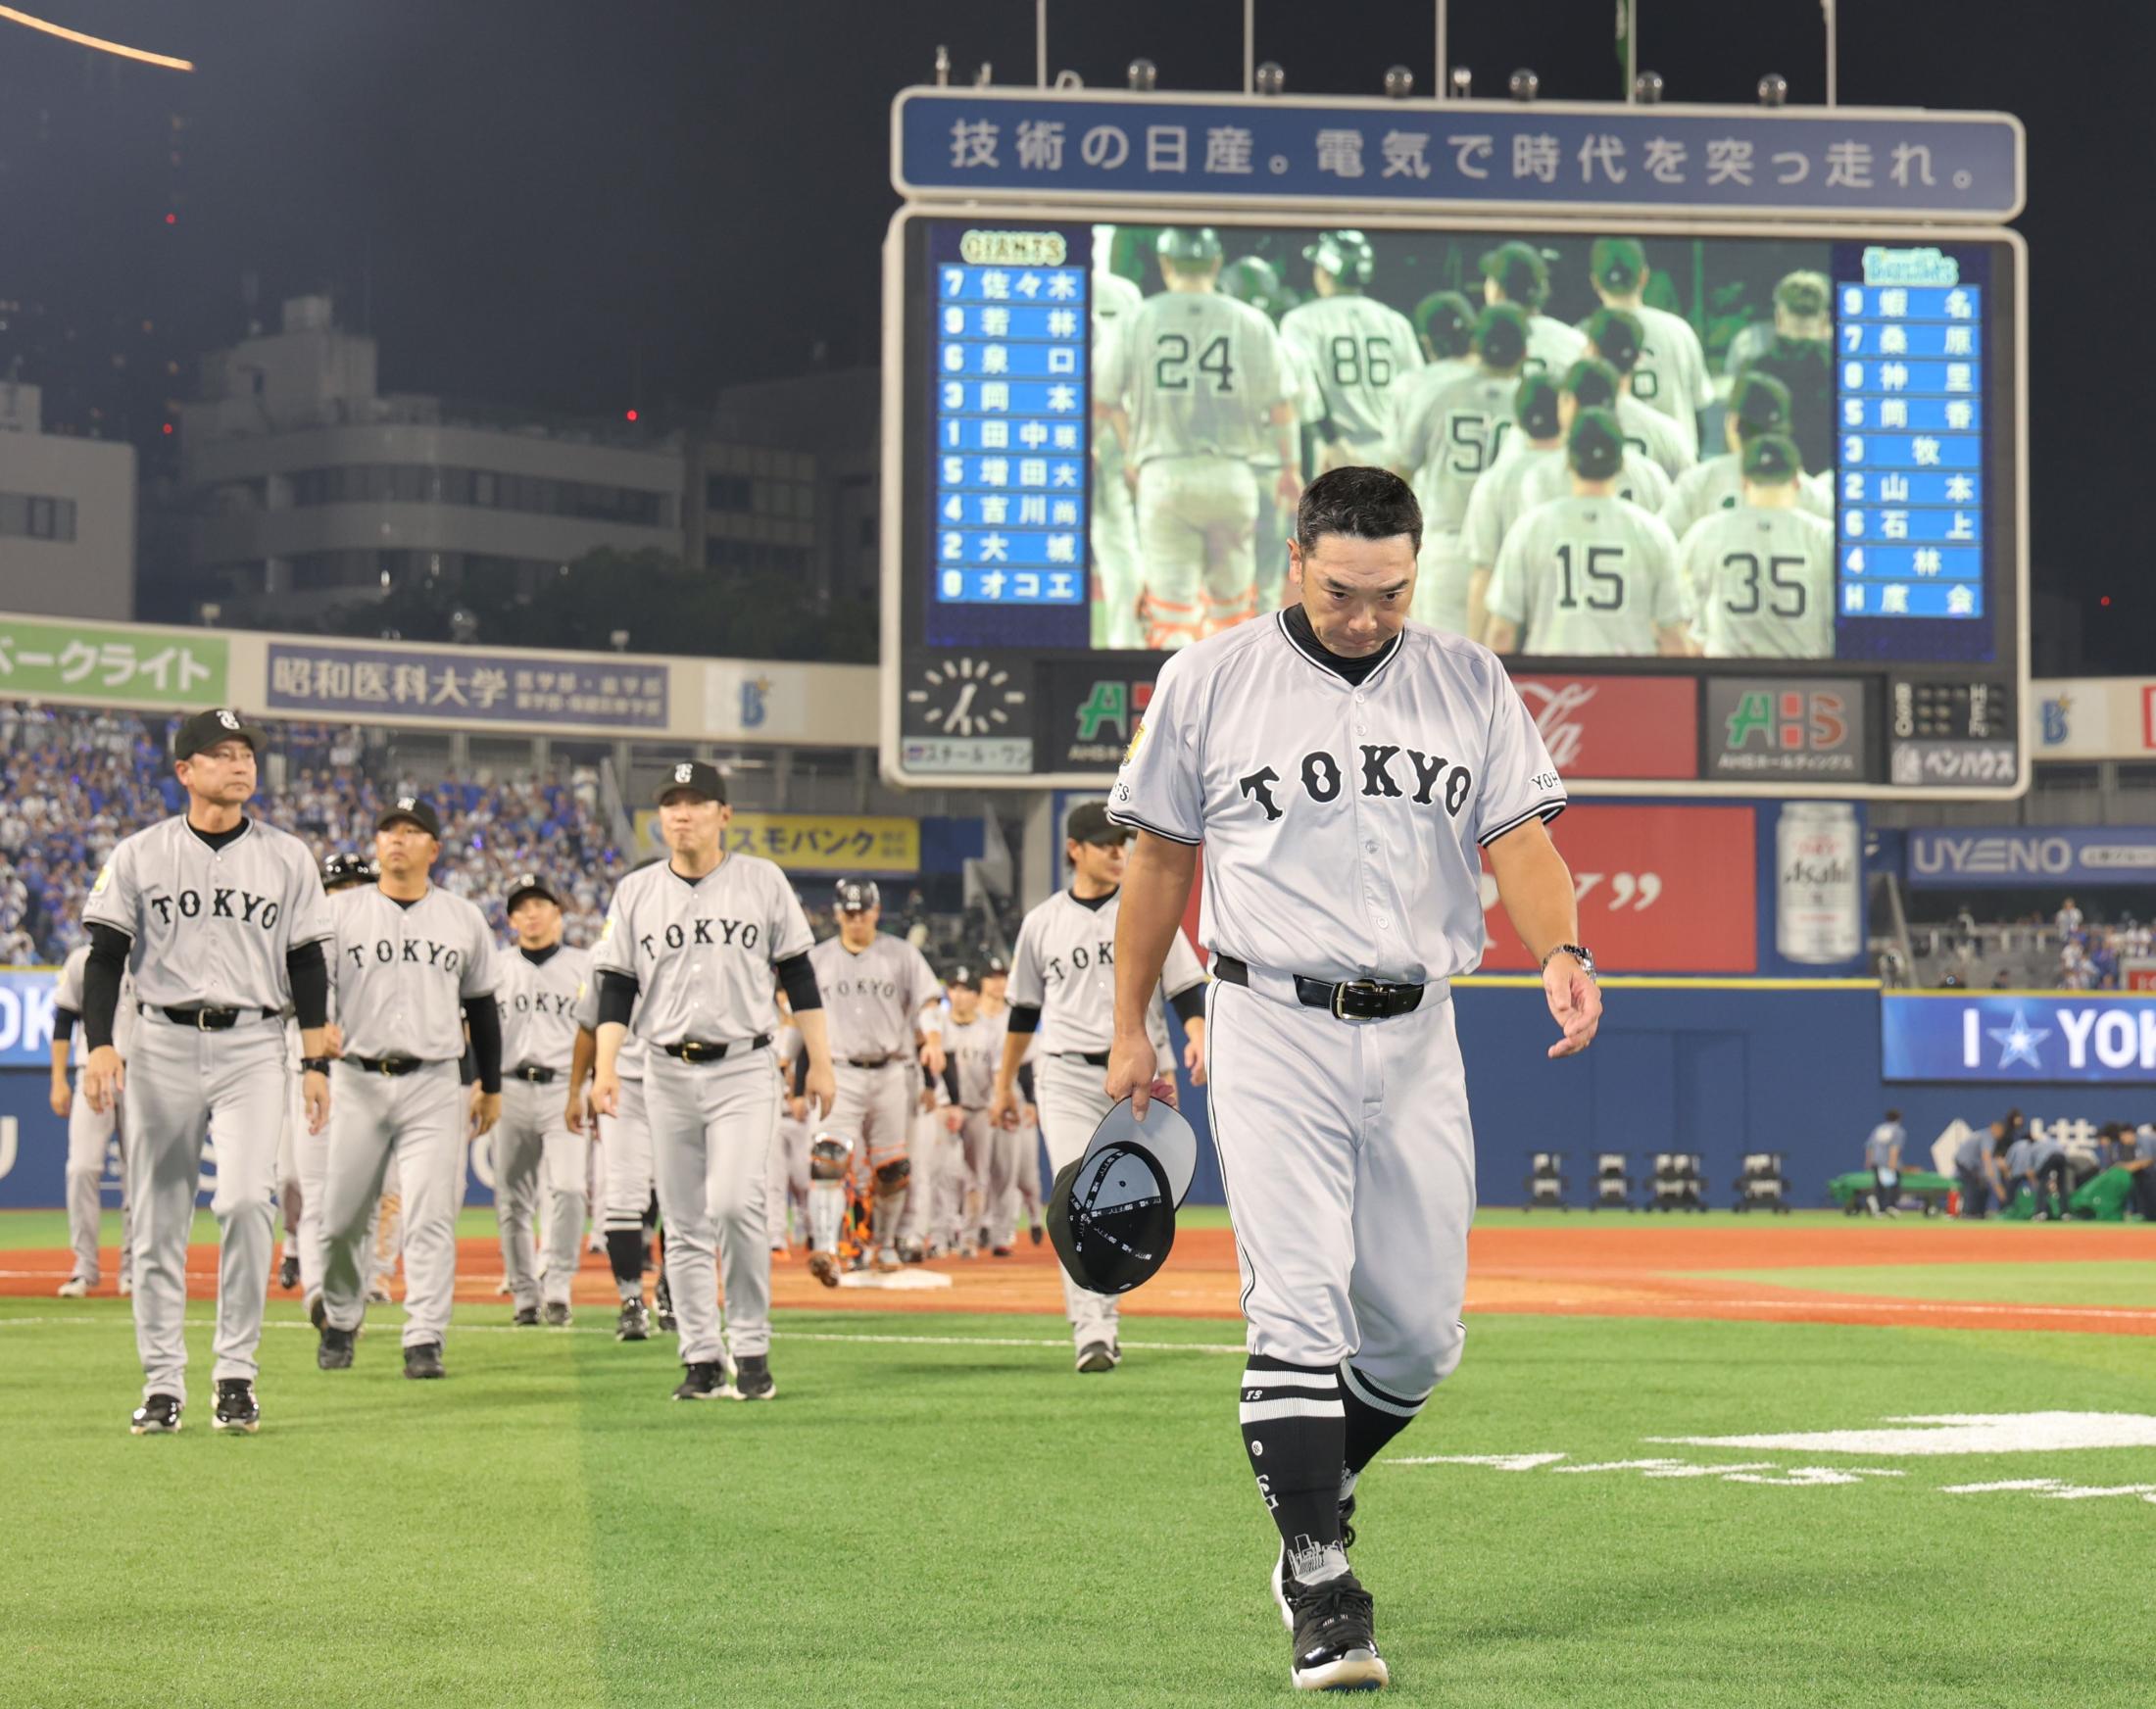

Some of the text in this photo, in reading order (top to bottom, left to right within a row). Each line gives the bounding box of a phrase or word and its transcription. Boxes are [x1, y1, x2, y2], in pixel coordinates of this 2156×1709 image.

[945, 269, 964, 297] 7
[1844, 324, 1863, 352] 7
[1155, 334, 1234, 390] 24
[1332, 336, 1392, 386] 86
[944, 381, 963, 409] 3
[1844, 398, 1864, 426] 5
[948, 418, 960, 447] 1
[1845, 435, 1864, 463] 3
[944, 457, 963, 484] 5
[1845, 471, 1974, 503] 2 山本
[944, 494, 962, 522] 4
[1881, 510, 1974, 539] 石上
[943, 532, 962, 560] 2
[1846, 548, 1865, 574] 4
[981, 569, 1074, 600] オコエ
[1556, 544, 1624, 610] 15
[1723, 552, 1806, 617] 35
[1845, 584, 1865, 611] H
[273, 657, 508, 709] 昭和医科大学
[1239, 743, 1473, 822] TOKYO
[720, 827, 874, 856] スモバンク
[1914, 837, 2072, 873] UYENO
[152, 888, 279, 930] TOKYO
[641, 918, 760, 961] TOKYO
[348, 939, 460, 973] TOKYO
[1050, 941, 1114, 980] TOK
[1963, 1008, 1981, 1067] I
